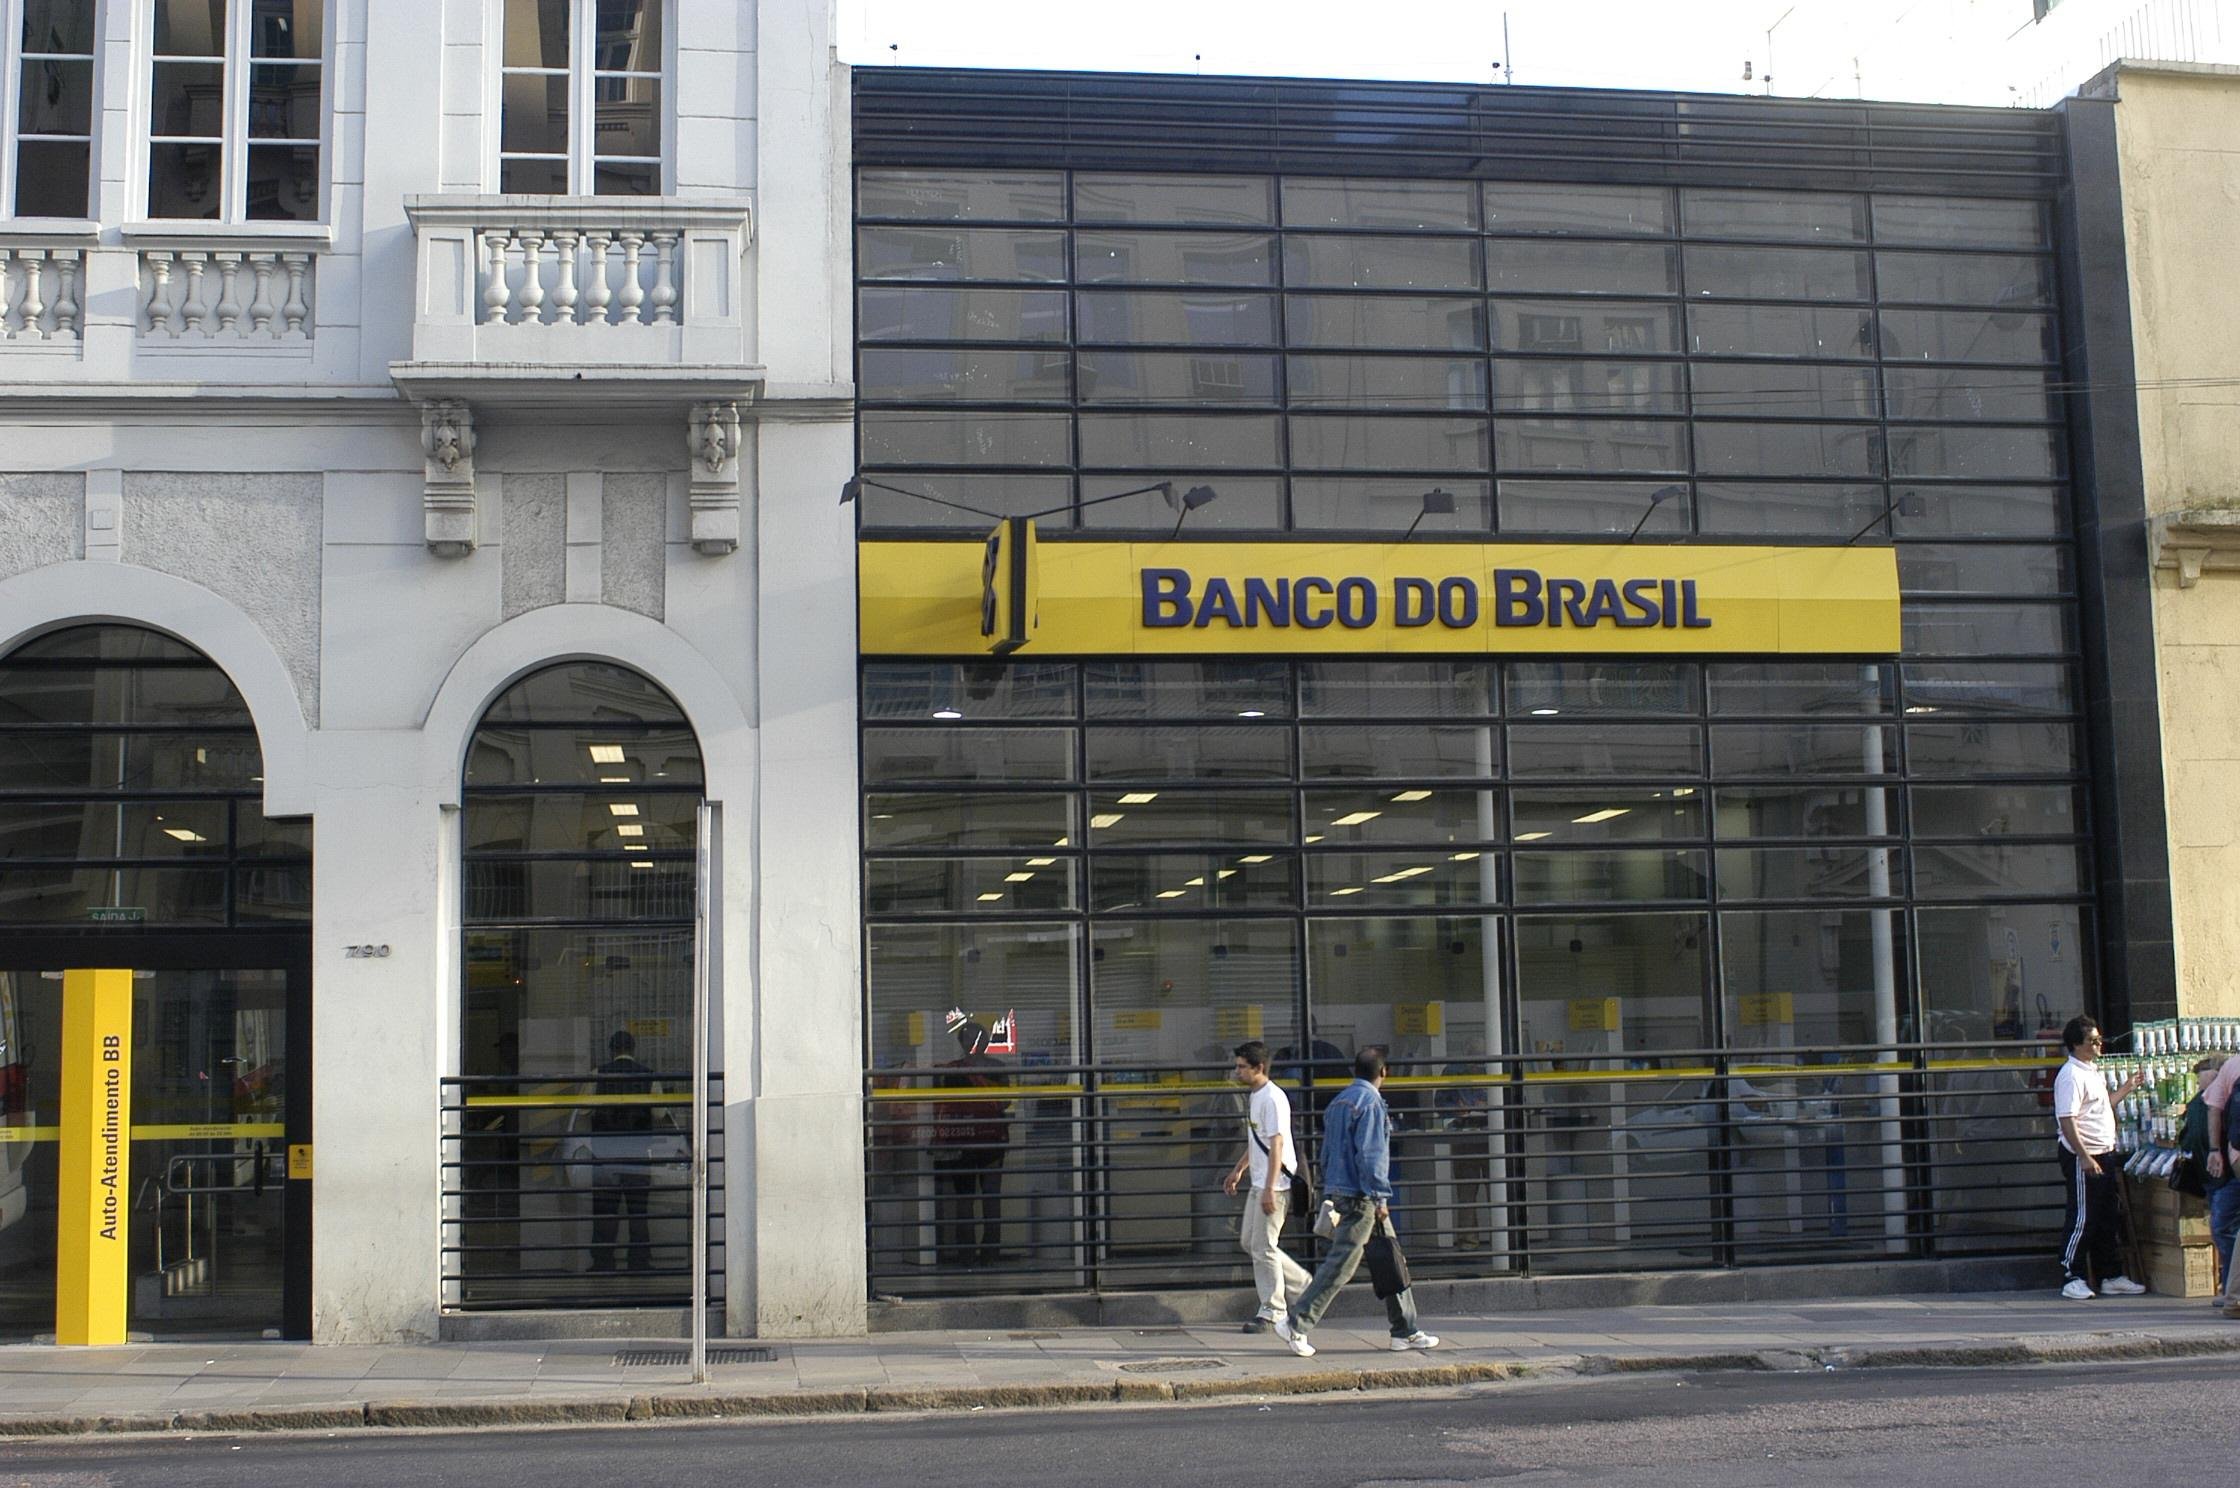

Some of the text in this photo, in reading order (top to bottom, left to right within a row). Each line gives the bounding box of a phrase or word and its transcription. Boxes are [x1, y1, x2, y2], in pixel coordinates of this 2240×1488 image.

[1142, 568, 1709, 628] BANCO DO BRASIL
[100, 1034, 120, 1240] Auto-Atendimento BB
